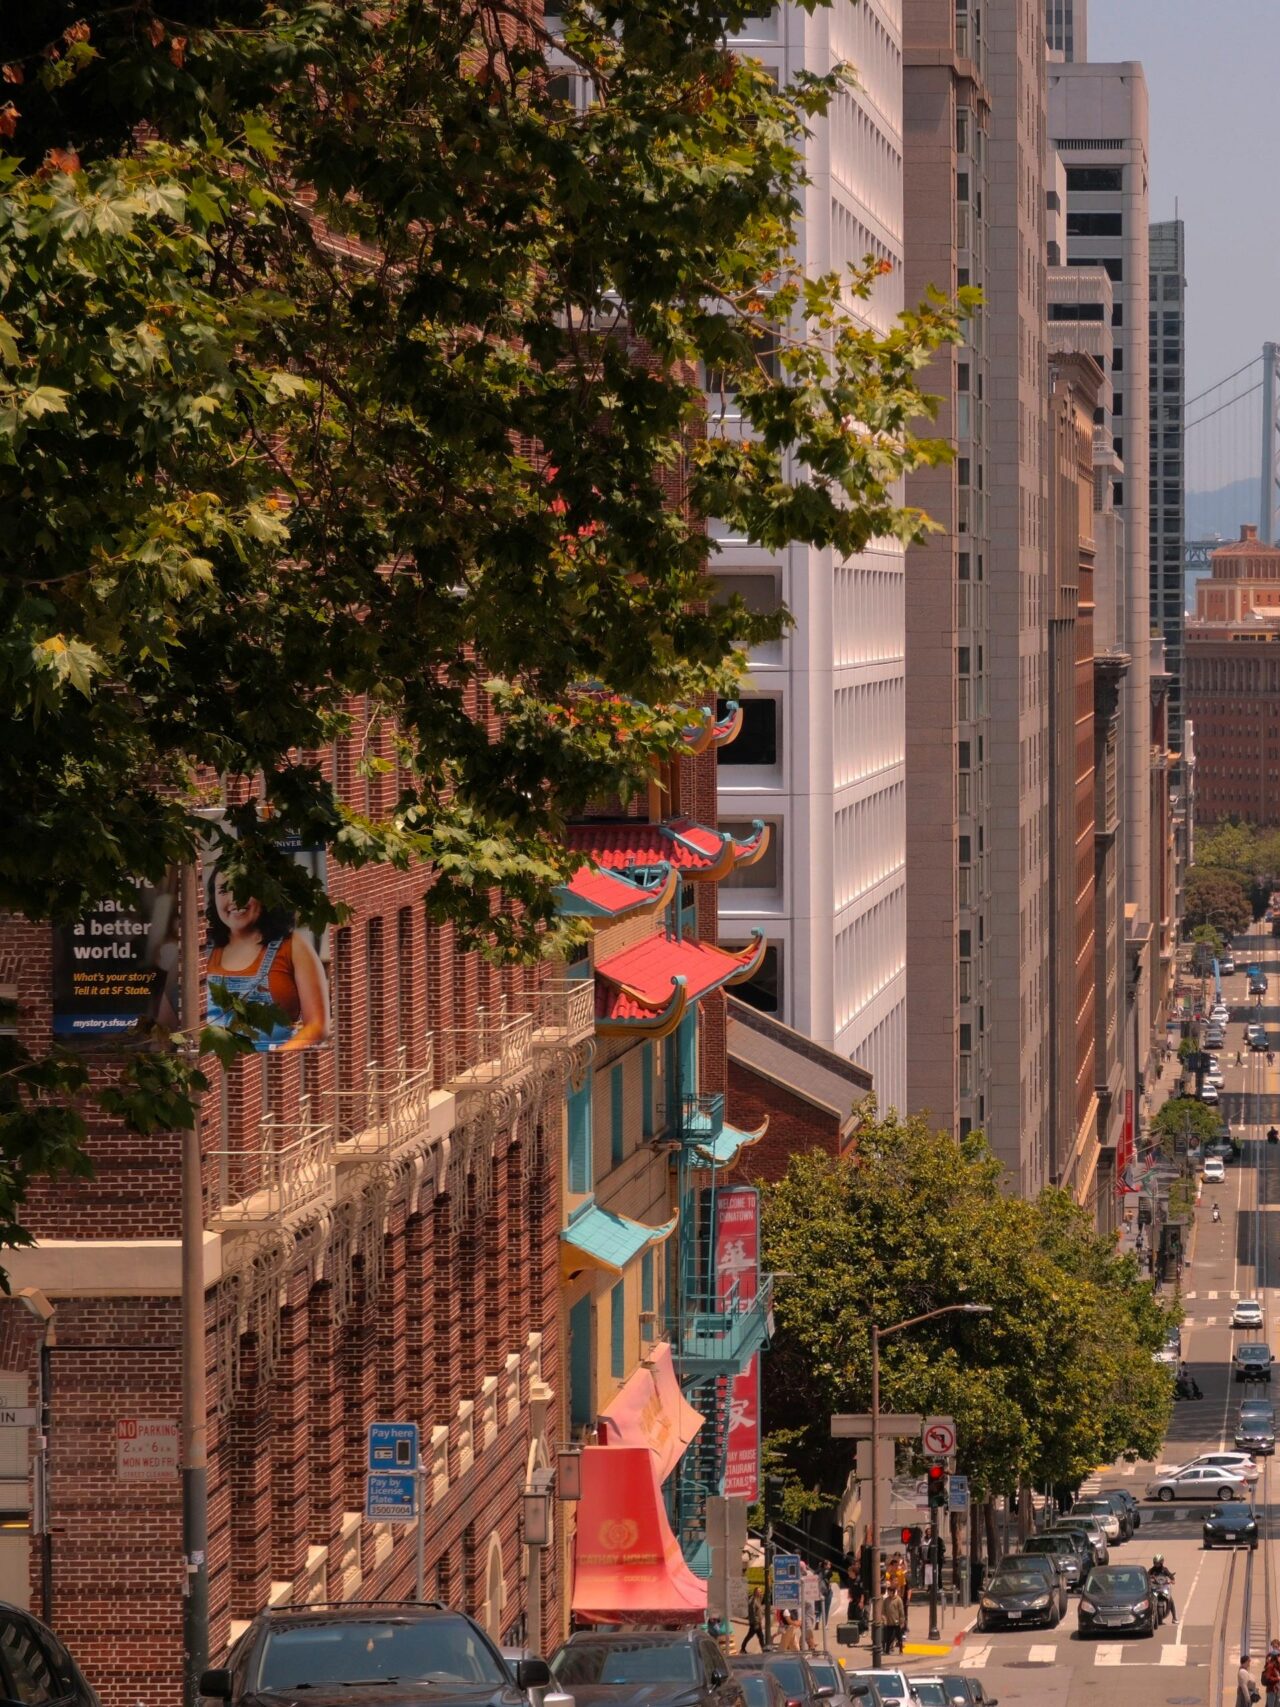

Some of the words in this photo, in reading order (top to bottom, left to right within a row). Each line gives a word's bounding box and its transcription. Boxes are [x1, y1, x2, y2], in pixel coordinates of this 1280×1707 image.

[73, 923, 85, 935] a
[91, 919, 152, 935] better
[73, 943, 137, 959] world.
[73, 972, 105, 982] What's
[106, 974, 127, 985] your
[128, 972, 157, 984] story?
[73, 986, 89, 996] Tell
[90, 986, 98, 996] it
[100, 986, 111, 996] at
[112, 986, 124, 996] SF
[125, 986, 151, 996] State.
[718, 1197, 745, 1209] WELCOME
[748, 1196, 756, 1208] TO
[720, 1210, 754, 1221] CHINATOWN
[120, 1421, 136, 1437] NO
[138, 1425, 177, 1436] PARKING
[372, 1429, 389, 1439] Pay
[391, 1429, 414, 1437] here
[739, 1450, 757, 1459] HOUSE
[122, 1458, 141, 1467] MON
[143, 1458, 160, 1467] WED
[161, 1458, 175, 1467] FRI
[371, 1479, 387, 1487] Pay
[389, 1479, 401, 1487] by
[370, 1487, 404, 1495] License
[580, 1554, 619, 1565] CATHAY
[623, 1554, 657, 1565] HOUSE
